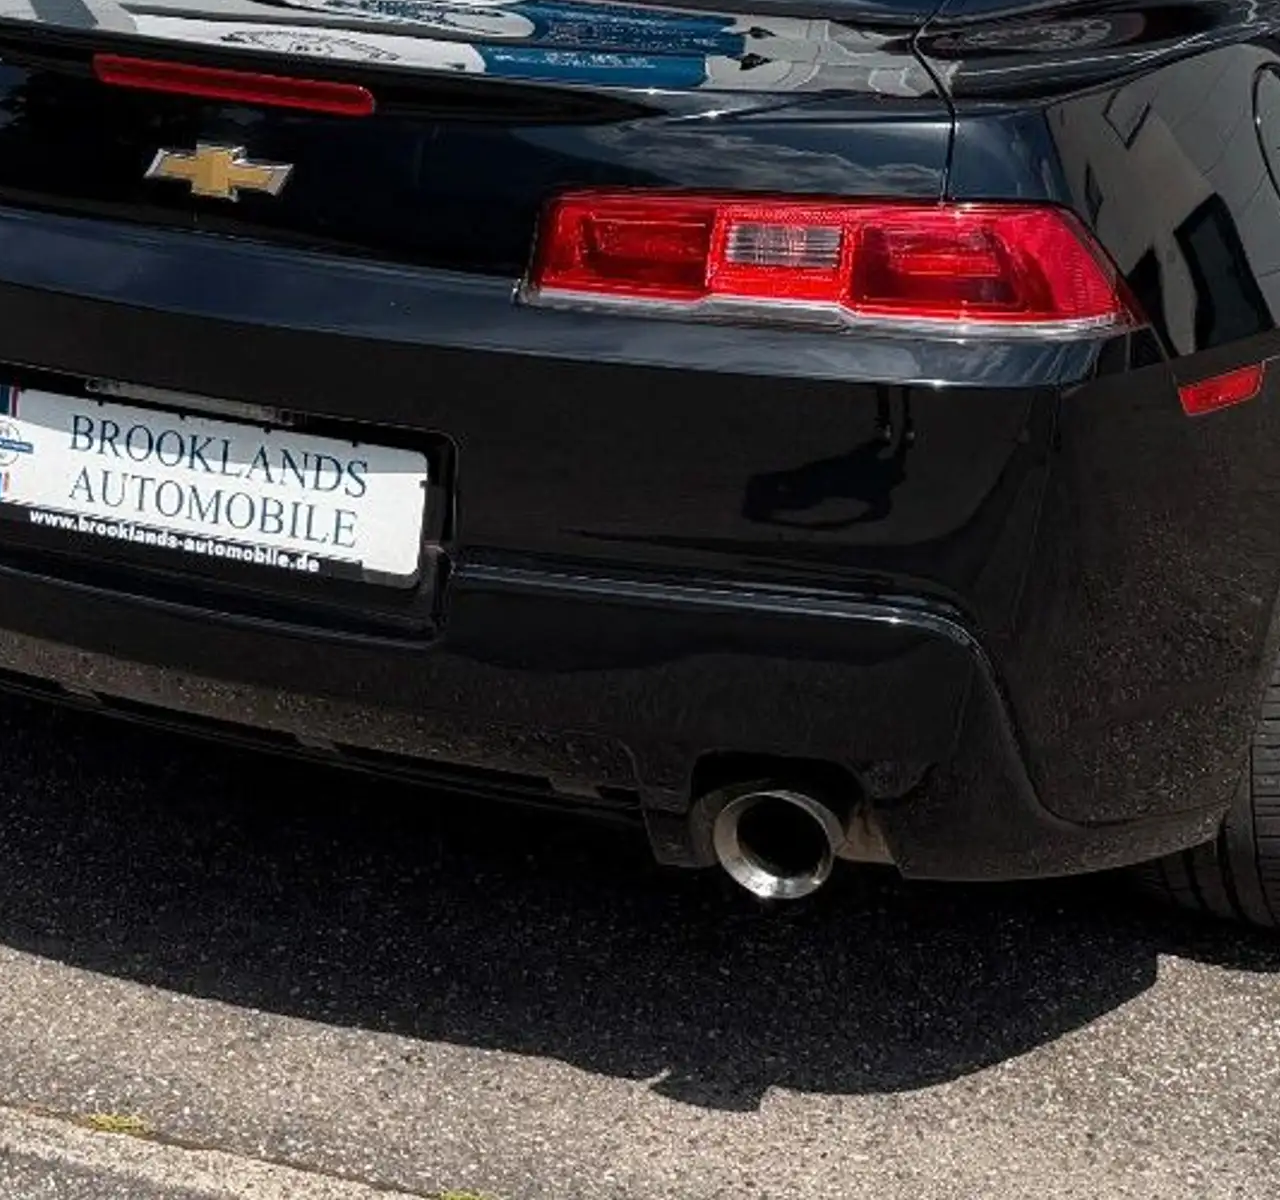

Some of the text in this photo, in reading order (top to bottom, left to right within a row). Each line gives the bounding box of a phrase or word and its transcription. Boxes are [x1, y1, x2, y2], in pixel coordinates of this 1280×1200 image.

[70, 414, 368, 498] BROOKLANDS
[29, 510, 320, 573] www.brooklands-automobile.de
[69, 466, 358, 548] AUTOMOBILE
